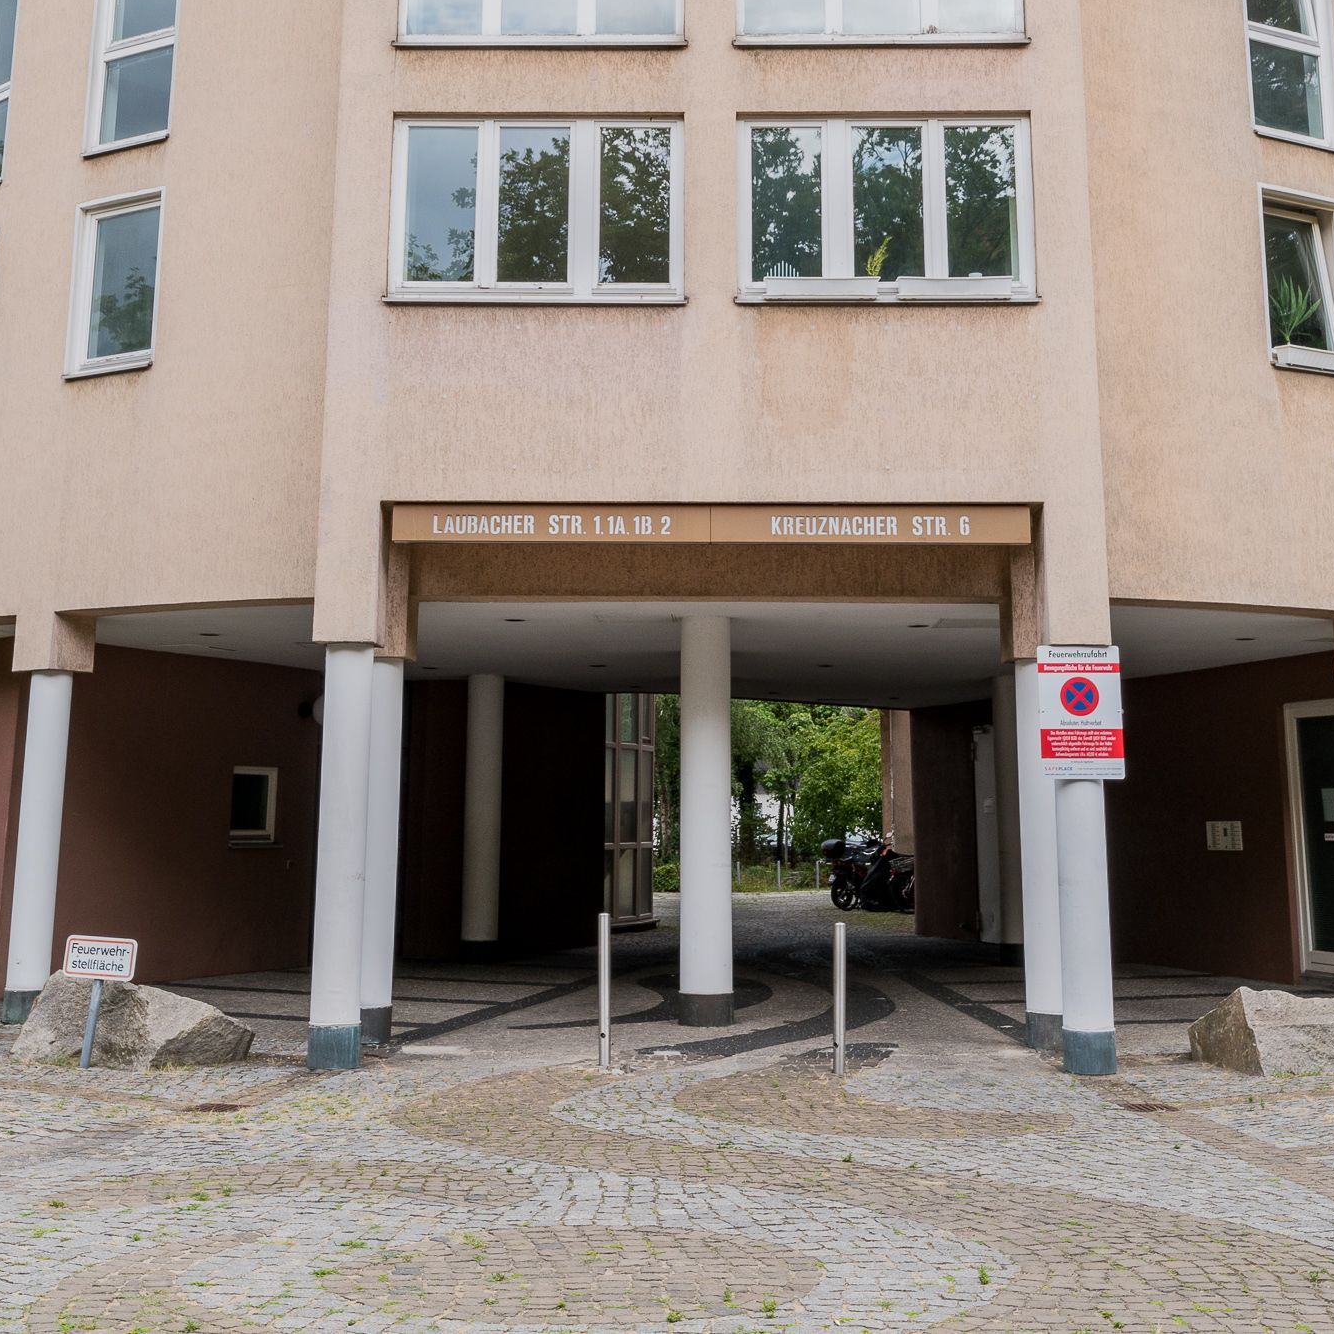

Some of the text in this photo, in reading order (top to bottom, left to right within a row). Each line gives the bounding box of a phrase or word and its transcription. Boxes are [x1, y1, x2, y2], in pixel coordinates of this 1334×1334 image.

[432, 514, 535, 535] LAUBACHER
[548, 514, 587, 535] STR.
[660, 516, 671, 535] 2
[771, 515, 971, 536] KREUZNACHER STR. 6
[1048, 649, 1108, 658] Feuerwehrzufahrt
[71, 942, 130, 957] Feuerwehr-
[71, 959, 124, 972] stellfläche
